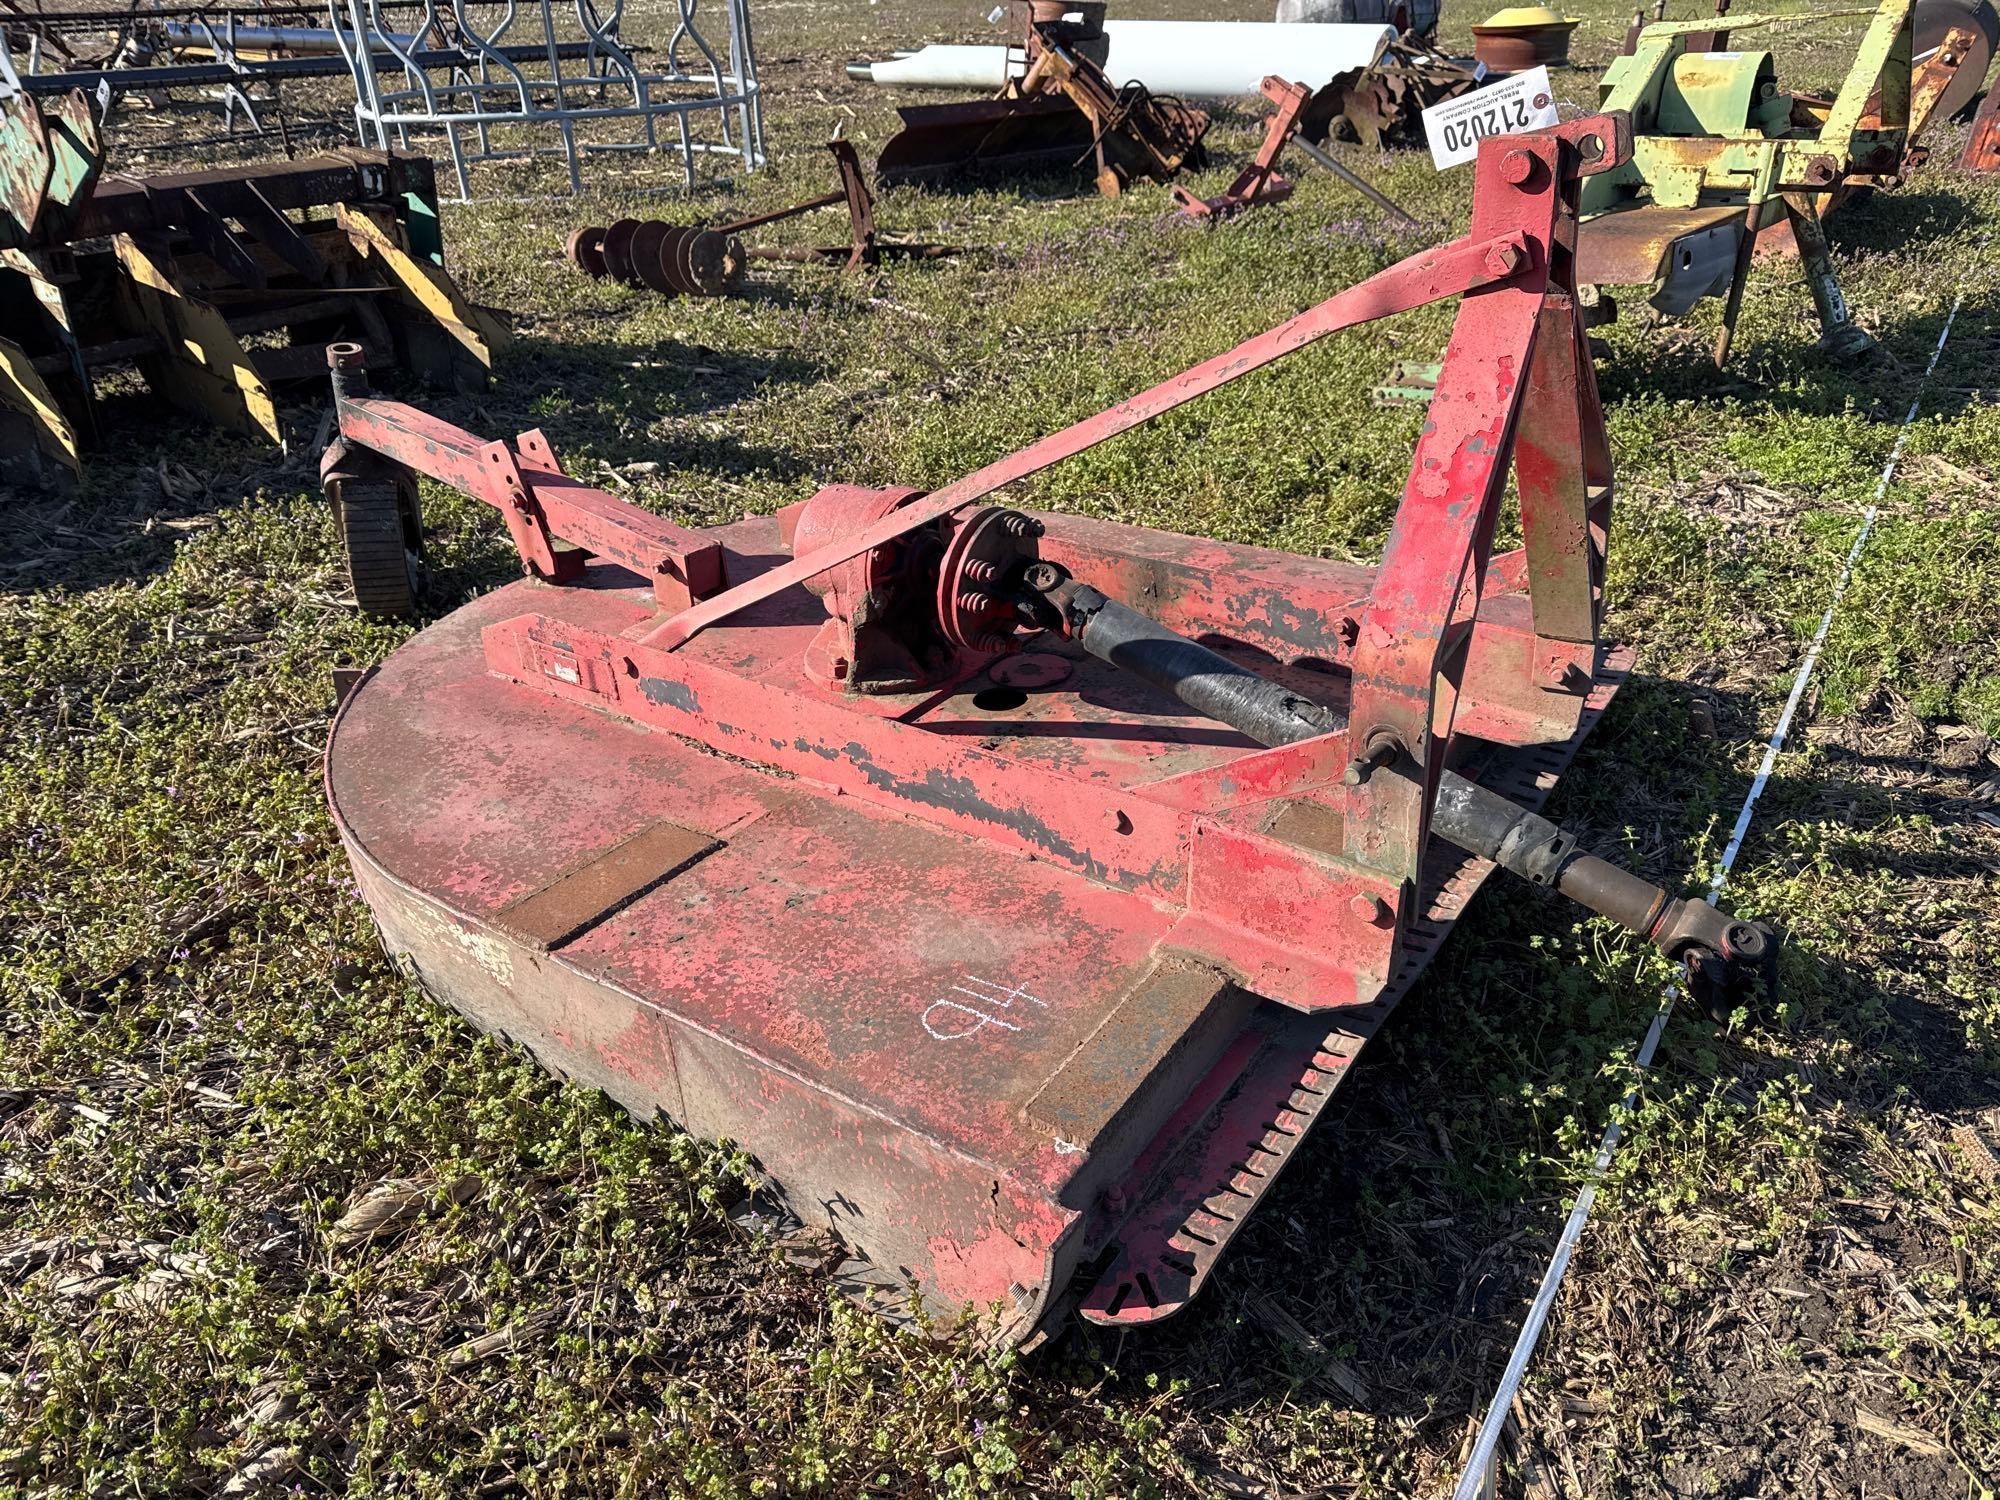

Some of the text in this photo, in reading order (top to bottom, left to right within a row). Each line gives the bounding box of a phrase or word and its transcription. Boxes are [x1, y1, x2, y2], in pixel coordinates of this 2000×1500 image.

[1442, 89, 1520, 121] REBEL AUCTION COMPANY
[1443, 98, 1529, 152] 212020
